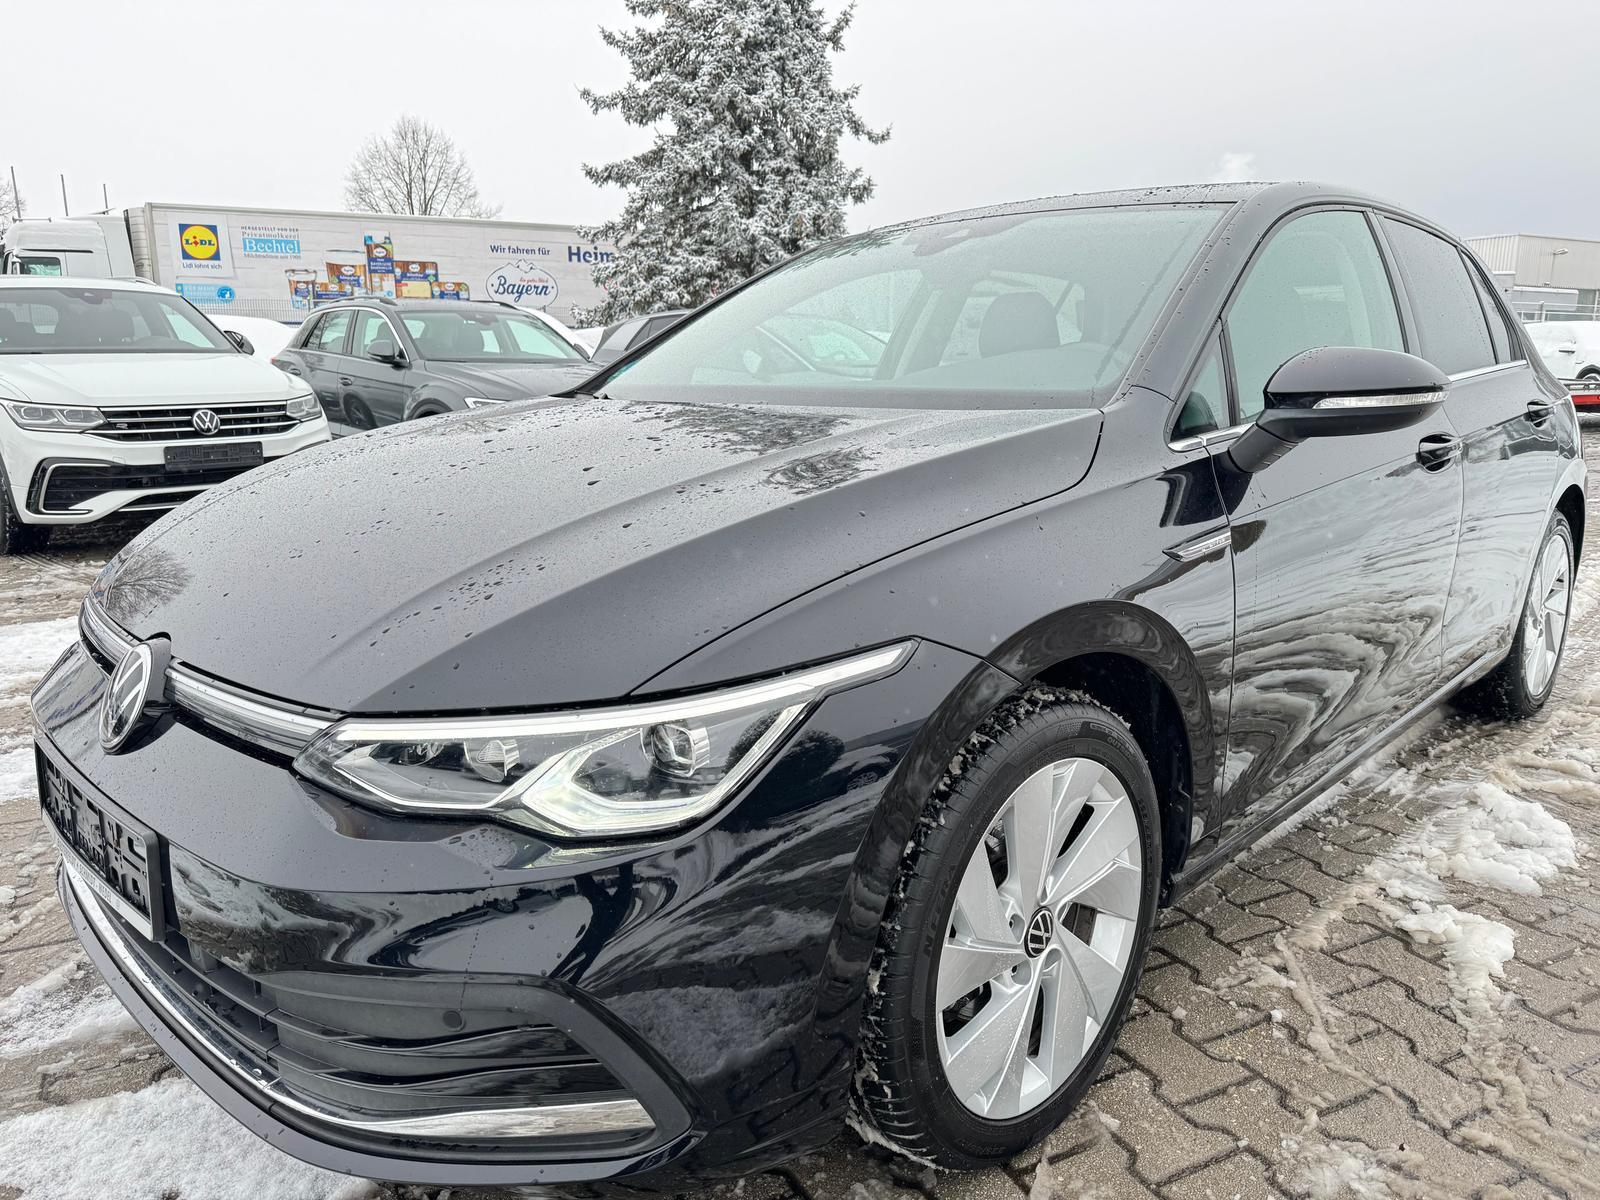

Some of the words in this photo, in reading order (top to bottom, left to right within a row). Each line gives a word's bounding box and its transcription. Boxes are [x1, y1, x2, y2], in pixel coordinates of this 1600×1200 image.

[245, 239, 299, 253] Bechtel
[489, 244, 506, 253] Wir
[507, 245, 536, 255] fahren
[537, 247, 551, 256] für
[494, 275, 551, 303] Bayern
